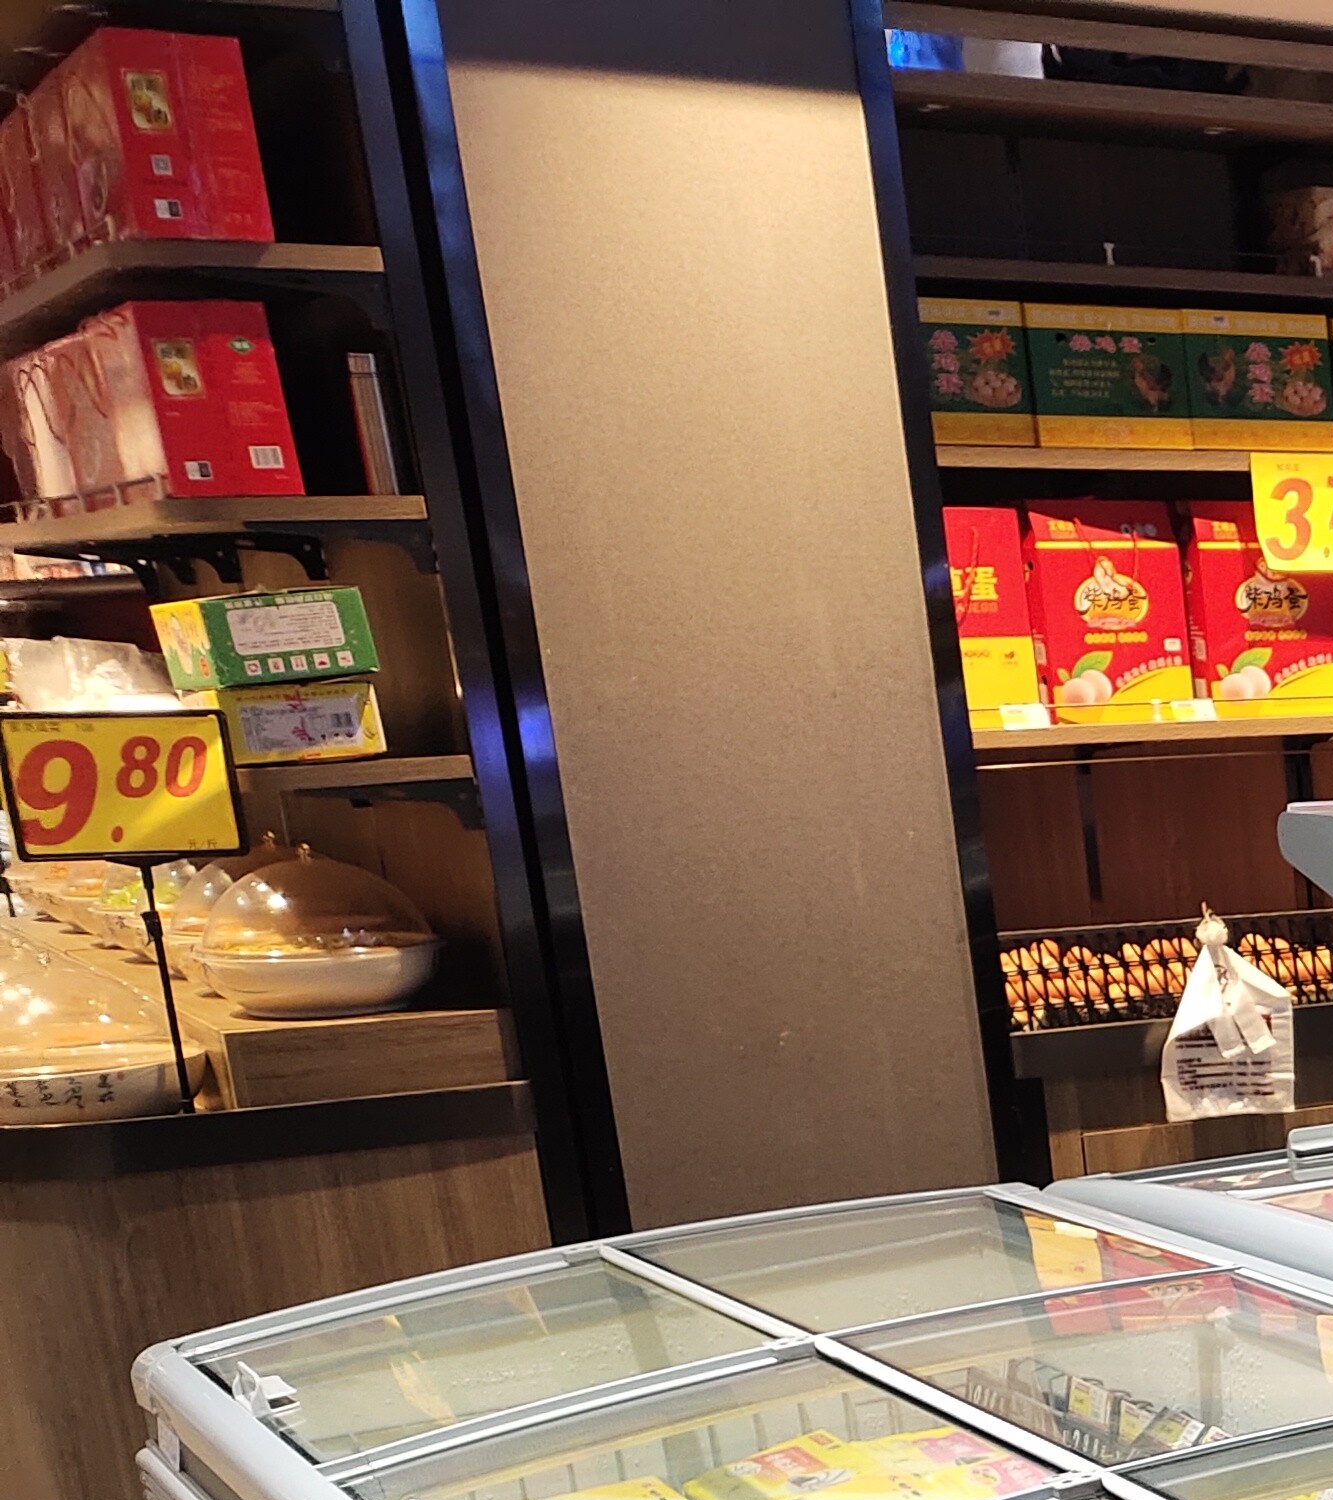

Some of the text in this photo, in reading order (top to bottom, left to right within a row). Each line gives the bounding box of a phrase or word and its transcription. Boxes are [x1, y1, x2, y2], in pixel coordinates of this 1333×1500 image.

[1244, 587, 1308, 610] 柴鸡蛋
[17, 735, 208, 846] 9.80
